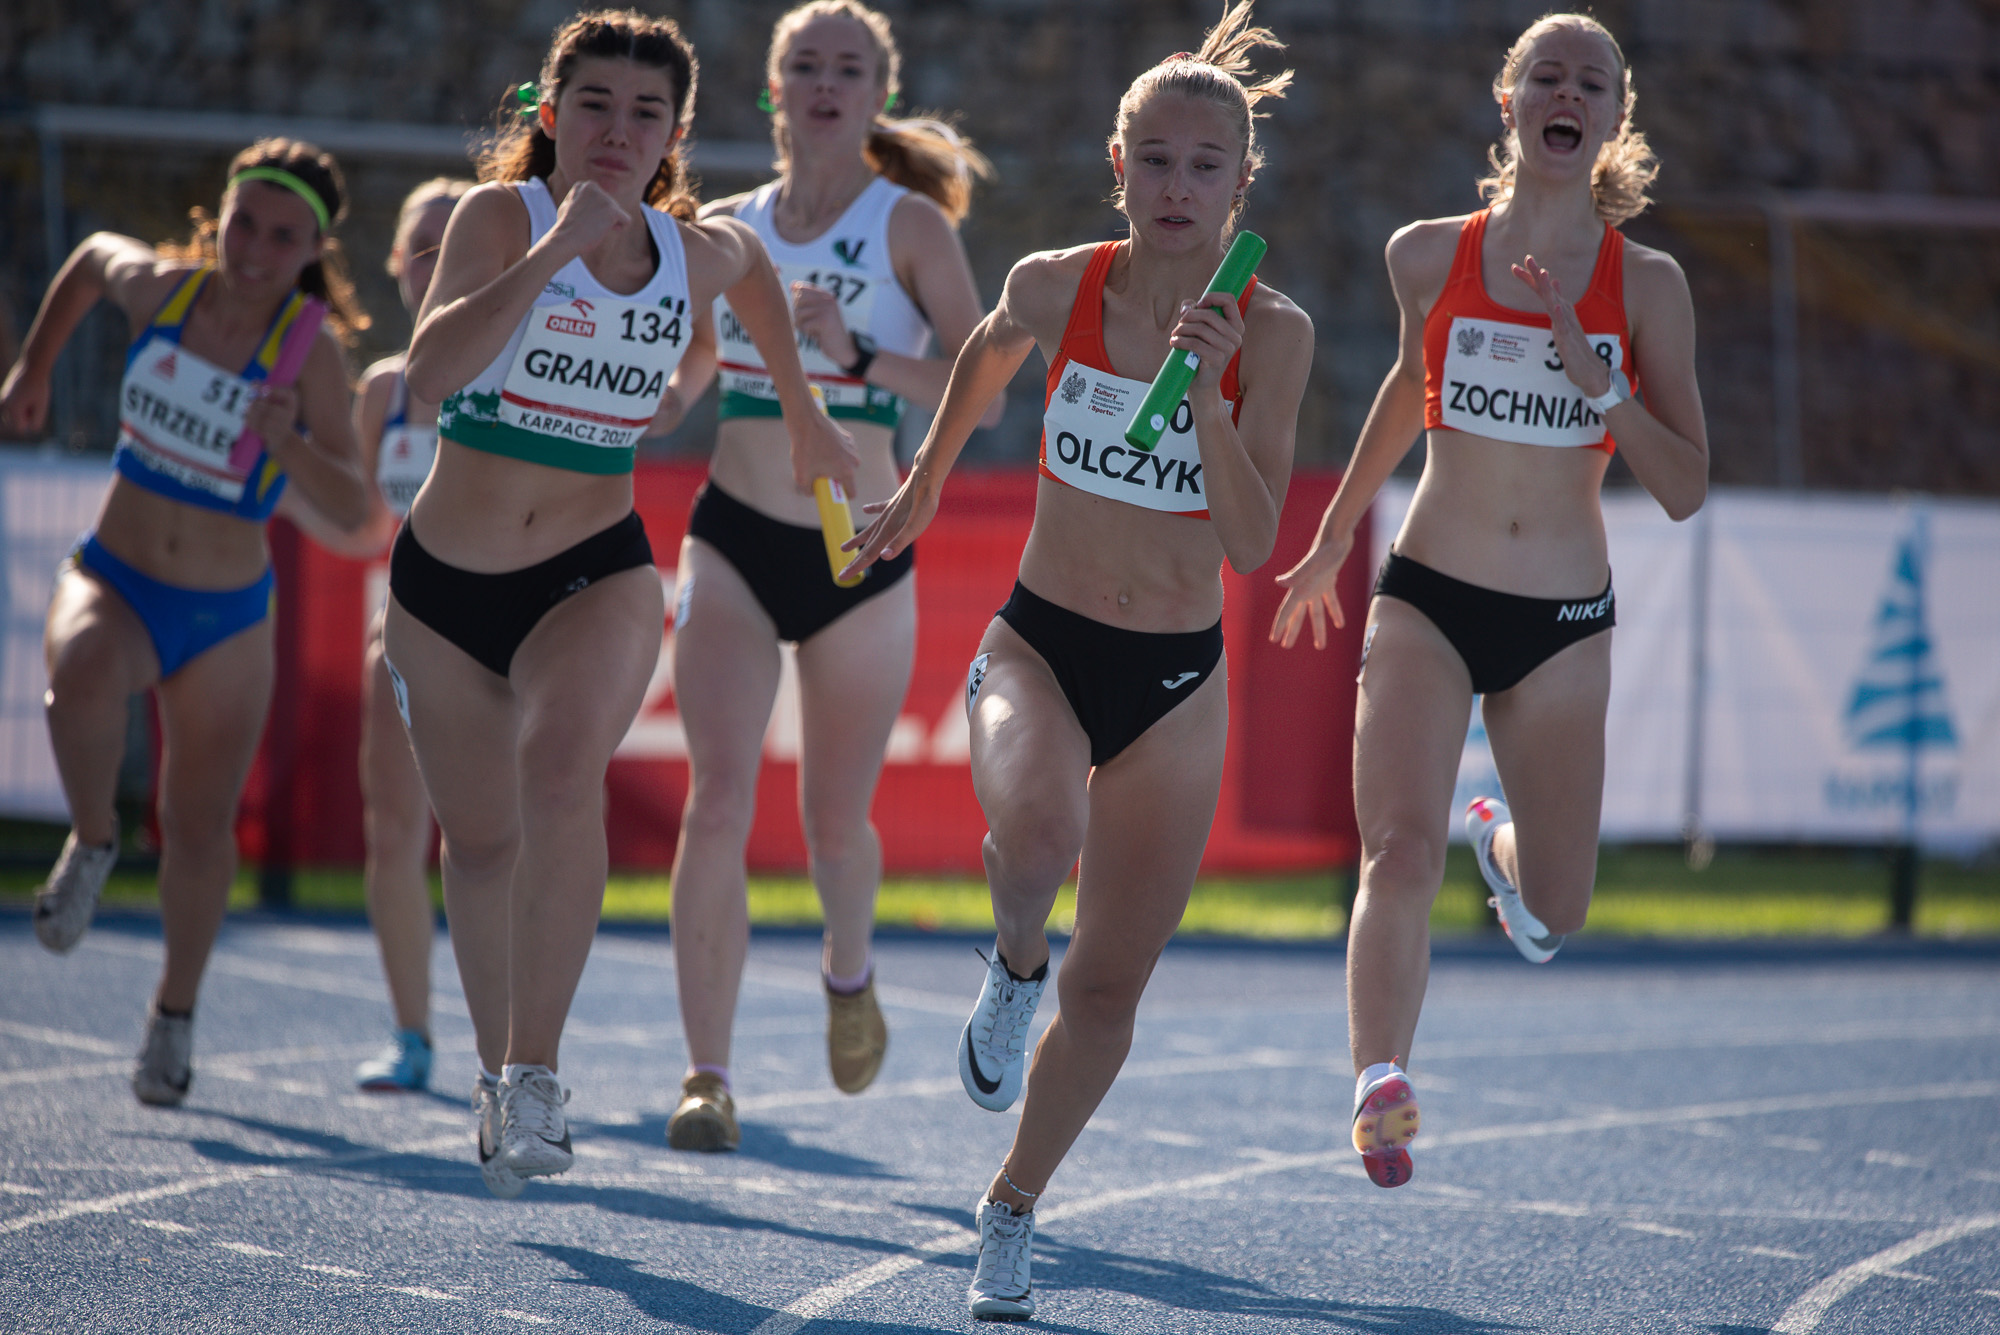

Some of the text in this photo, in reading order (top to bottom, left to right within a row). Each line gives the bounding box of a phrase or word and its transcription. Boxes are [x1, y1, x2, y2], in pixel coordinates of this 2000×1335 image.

[549, 316, 594, 336] ORLEN
[620, 308, 682, 348] 134
[1543, 340, 1612, 371] 38
[524, 348, 663, 399] GRANDA
[1093, 387, 1118, 399] Kultury
[518, 411, 598, 440] KARPACZ
[599, 428, 633, 446] 2021
[1056, 430, 1203, 495] OLCZYK
[1556, 597, 1607, 622] NIKE
